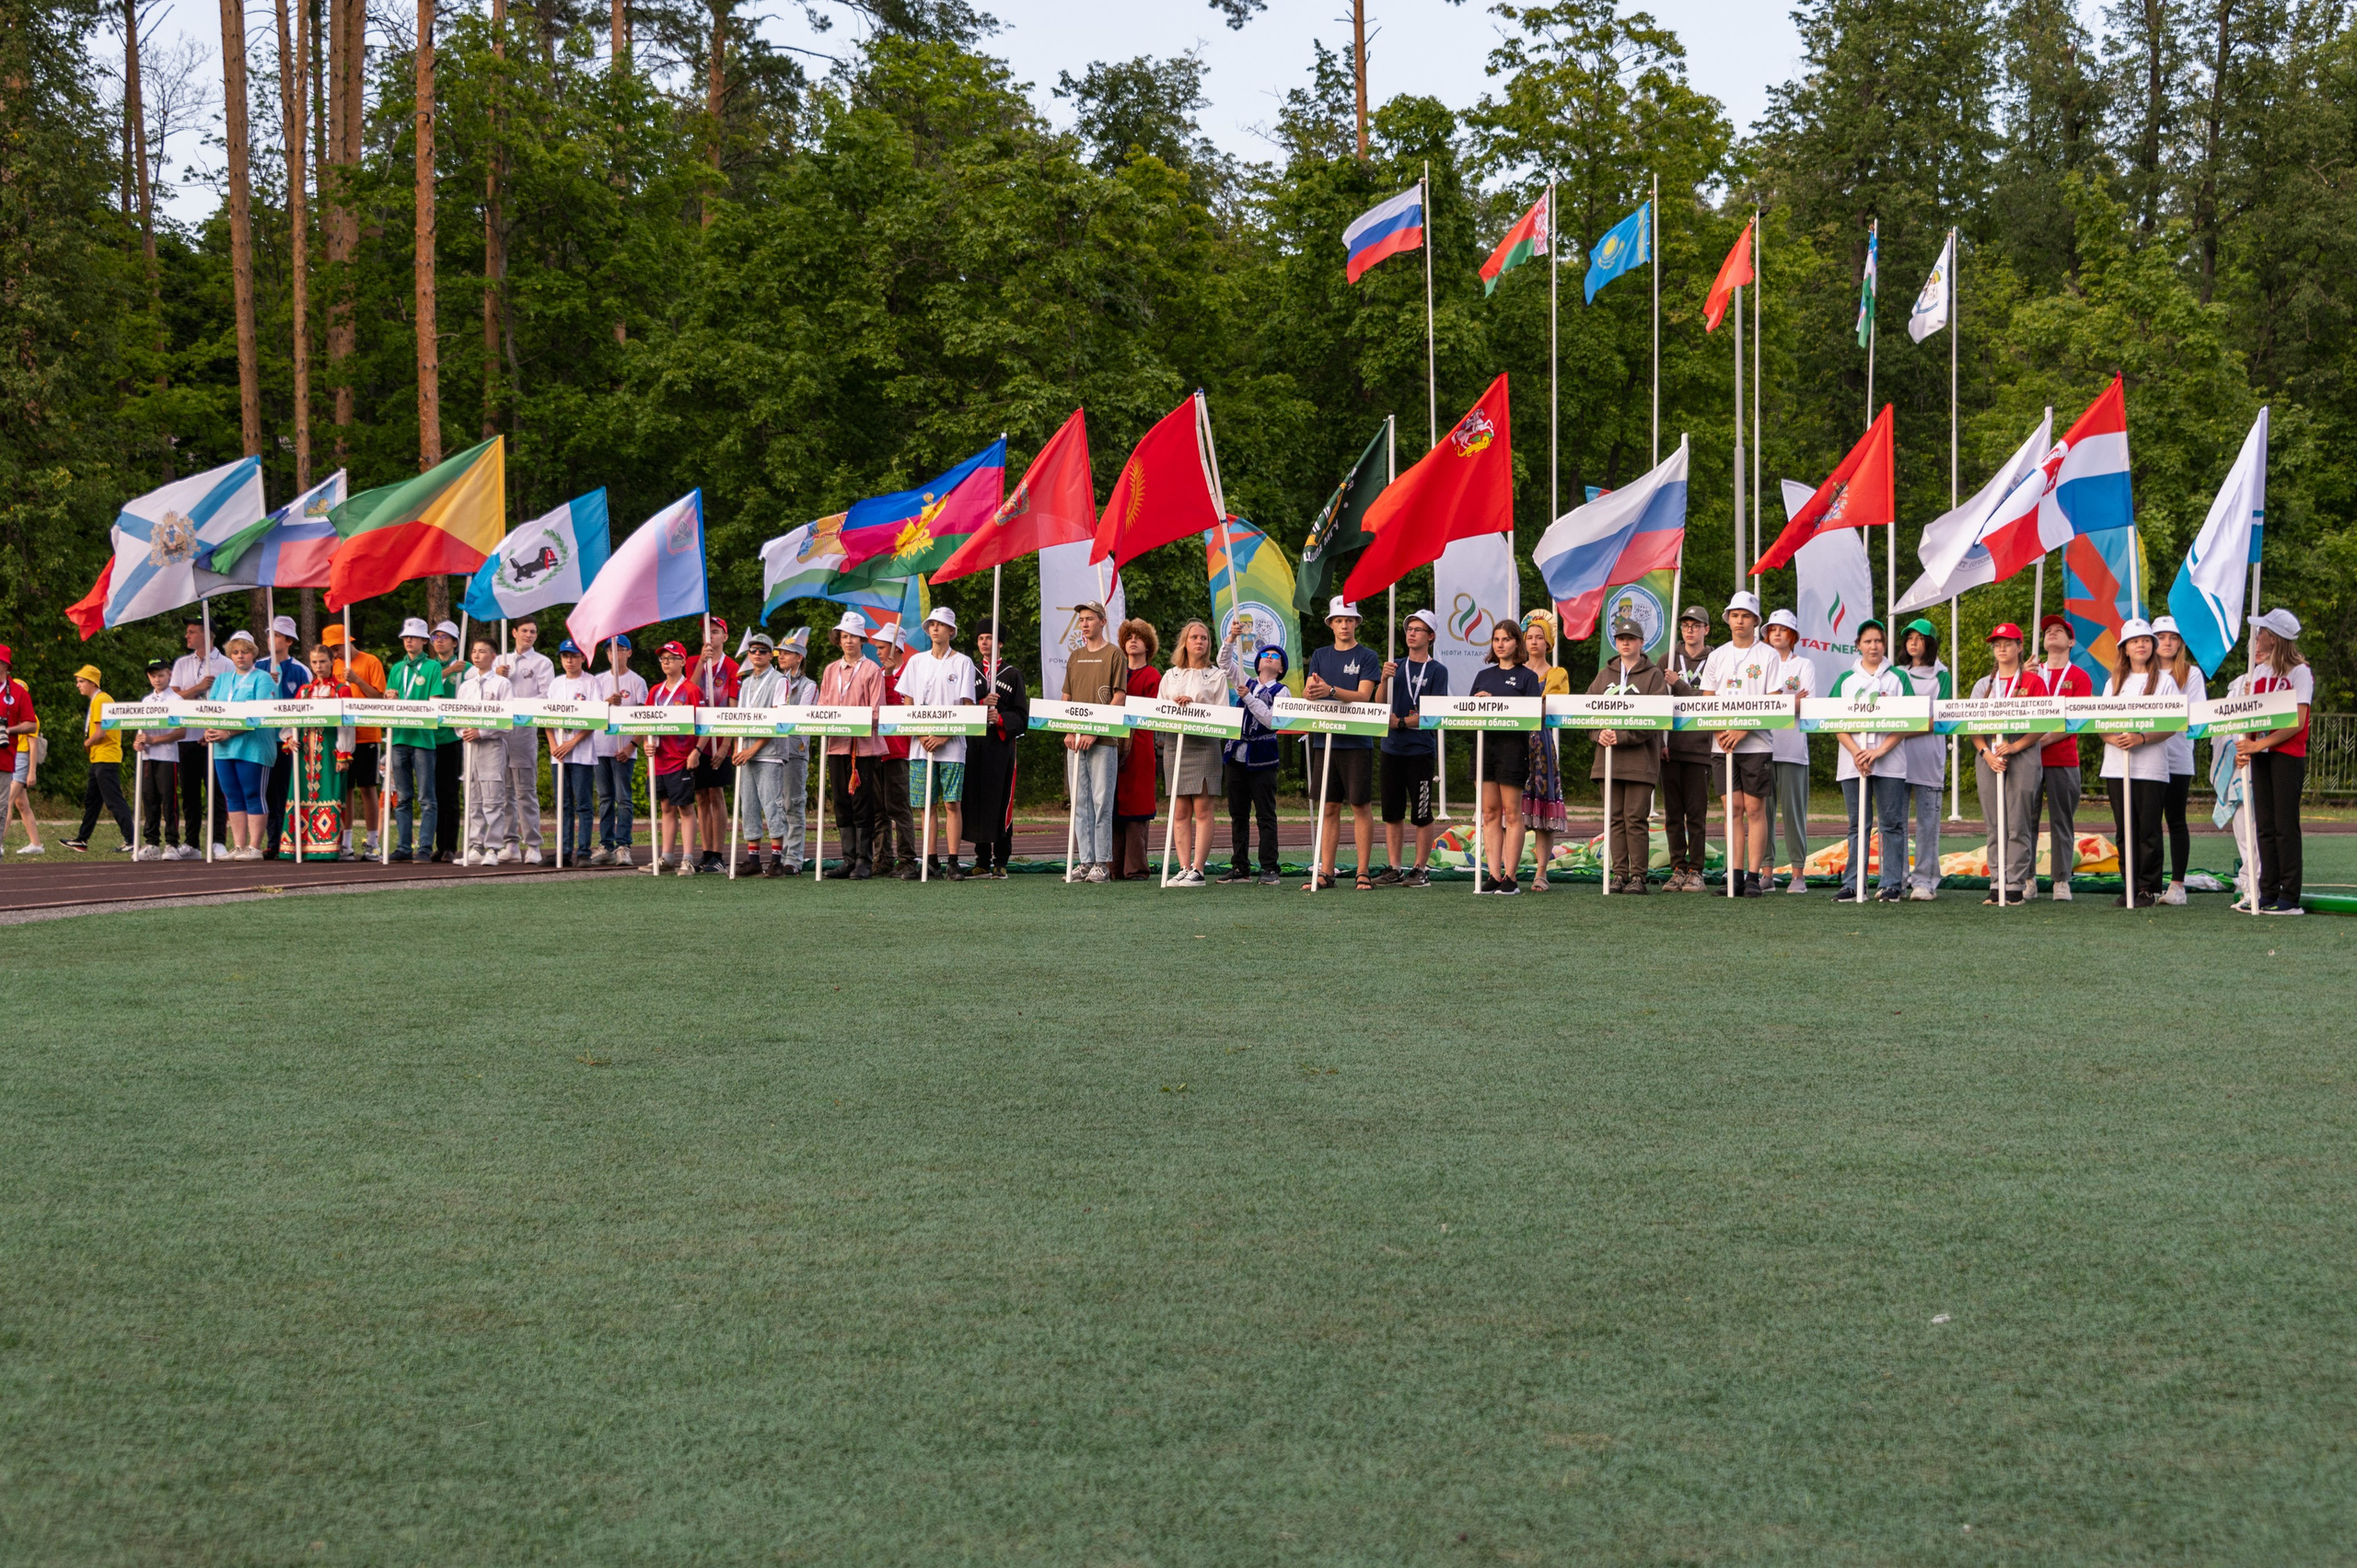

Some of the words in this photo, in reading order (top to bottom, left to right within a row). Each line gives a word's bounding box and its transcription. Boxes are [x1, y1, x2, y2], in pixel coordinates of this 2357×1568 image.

[1800, 639, 1863, 655] TATNEF
[196, 706, 226, 714] «АЛМАЗ»
[274, 704, 314, 714] «КВАРЦИТ»
[345, 703, 395, 712] «ВЛАДИМИРСКИЕ
[396, 705, 435, 713] САМОЦВЕТЫ»
[484, 703, 505, 713] КРАЙ»
[543, 705, 578, 713] «ЧАРОИТ»
[1277, 703, 1338, 714] «ГЕОЛОГИЧЕСКАЯ
[1340, 705, 1365, 715] ШКОЛА
[1367, 707, 1387, 716] МГУ»
[1453, 702, 1476, 712] «ШФ
[1478, 702, 1509, 711] МГРИ»
[1585, 701, 1635, 710] «СИБИРЬ»
[1675, 702, 1719, 712] «ОМСКИЕ
[1721, 701, 1787, 711] МАМОНТЯТА»
[1848, 703, 1880, 713] «РИФ»
[1980, 702, 1989, 710] ДО
[1990, 701, 2019, 709] «ДВОРЕЦ
[2020, 700, 2052, 709] ДЕТСКОГО
[2097, 703, 2126, 712] КОМАНДА
[2128, 703, 2163, 711] ПЕРМСКОГО
[2164, 702, 2184, 710] КРАЯ»
[2214, 700, 2263, 716] «АДАМАНТ»
[108, 706, 145, 715] «АЛТАЙСКИЕ
[630, 711, 668, 720] «КУЗБАСС»
[806, 711, 841, 719] «КАССИТ»
[907, 710, 957, 719] «КАВКАЗИТ»
[1065, 707, 1093, 717] «GEOS»
[1155, 705, 1211, 718] «СТРАННИК»
[1939, 710, 1986, 719] (ЮНОШЕСКОГО)
[261, 717, 302, 726] Белгородская
[354, 717, 398, 726] Владимирская
[399, 718, 424, 726] область
[533, 717, 563, 726] Иркутская
[717, 712, 751, 721] «ГЕОКЛУБ
[753, 713, 767, 721] НК»
[1562, 717, 1622, 726] Новосибирская
[1624, 717, 1656, 726] область
[221, 719, 242, 727] область
[484, 718, 497, 727] край
[1047, 720, 1092, 732] Красноярский
[1094, 722, 1109, 733] край
[1136, 718, 1182, 730] Кыргызская
[1184, 722, 1227, 735] республика
[1319, 721, 1346, 731] Москва
[1441, 717, 1486, 726] Московская
[1488, 718, 1519, 727] область
[1697, 717, 1728, 727] Омская
[1729, 717, 1761, 726] область
[1819, 720, 1875, 729] Оренбургская
[1876, 718, 1909, 728] область
[1968, 720, 2008, 731] Пермский
[2010, 720, 2030, 730] край
[2095, 718, 2134, 730] Пермский
[2135, 718, 2154, 729] край
[2208, 720, 2249, 733] Республика
[2250, 718, 2271, 729] Алтай
[619, 725, 656, 733] Кемеровская
[709, 726, 747, 734] Кемеровская
[795, 725, 827, 734] Кировская
[896, 725, 948, 734] Краснодарский
[949, 725, 966, 734] край
